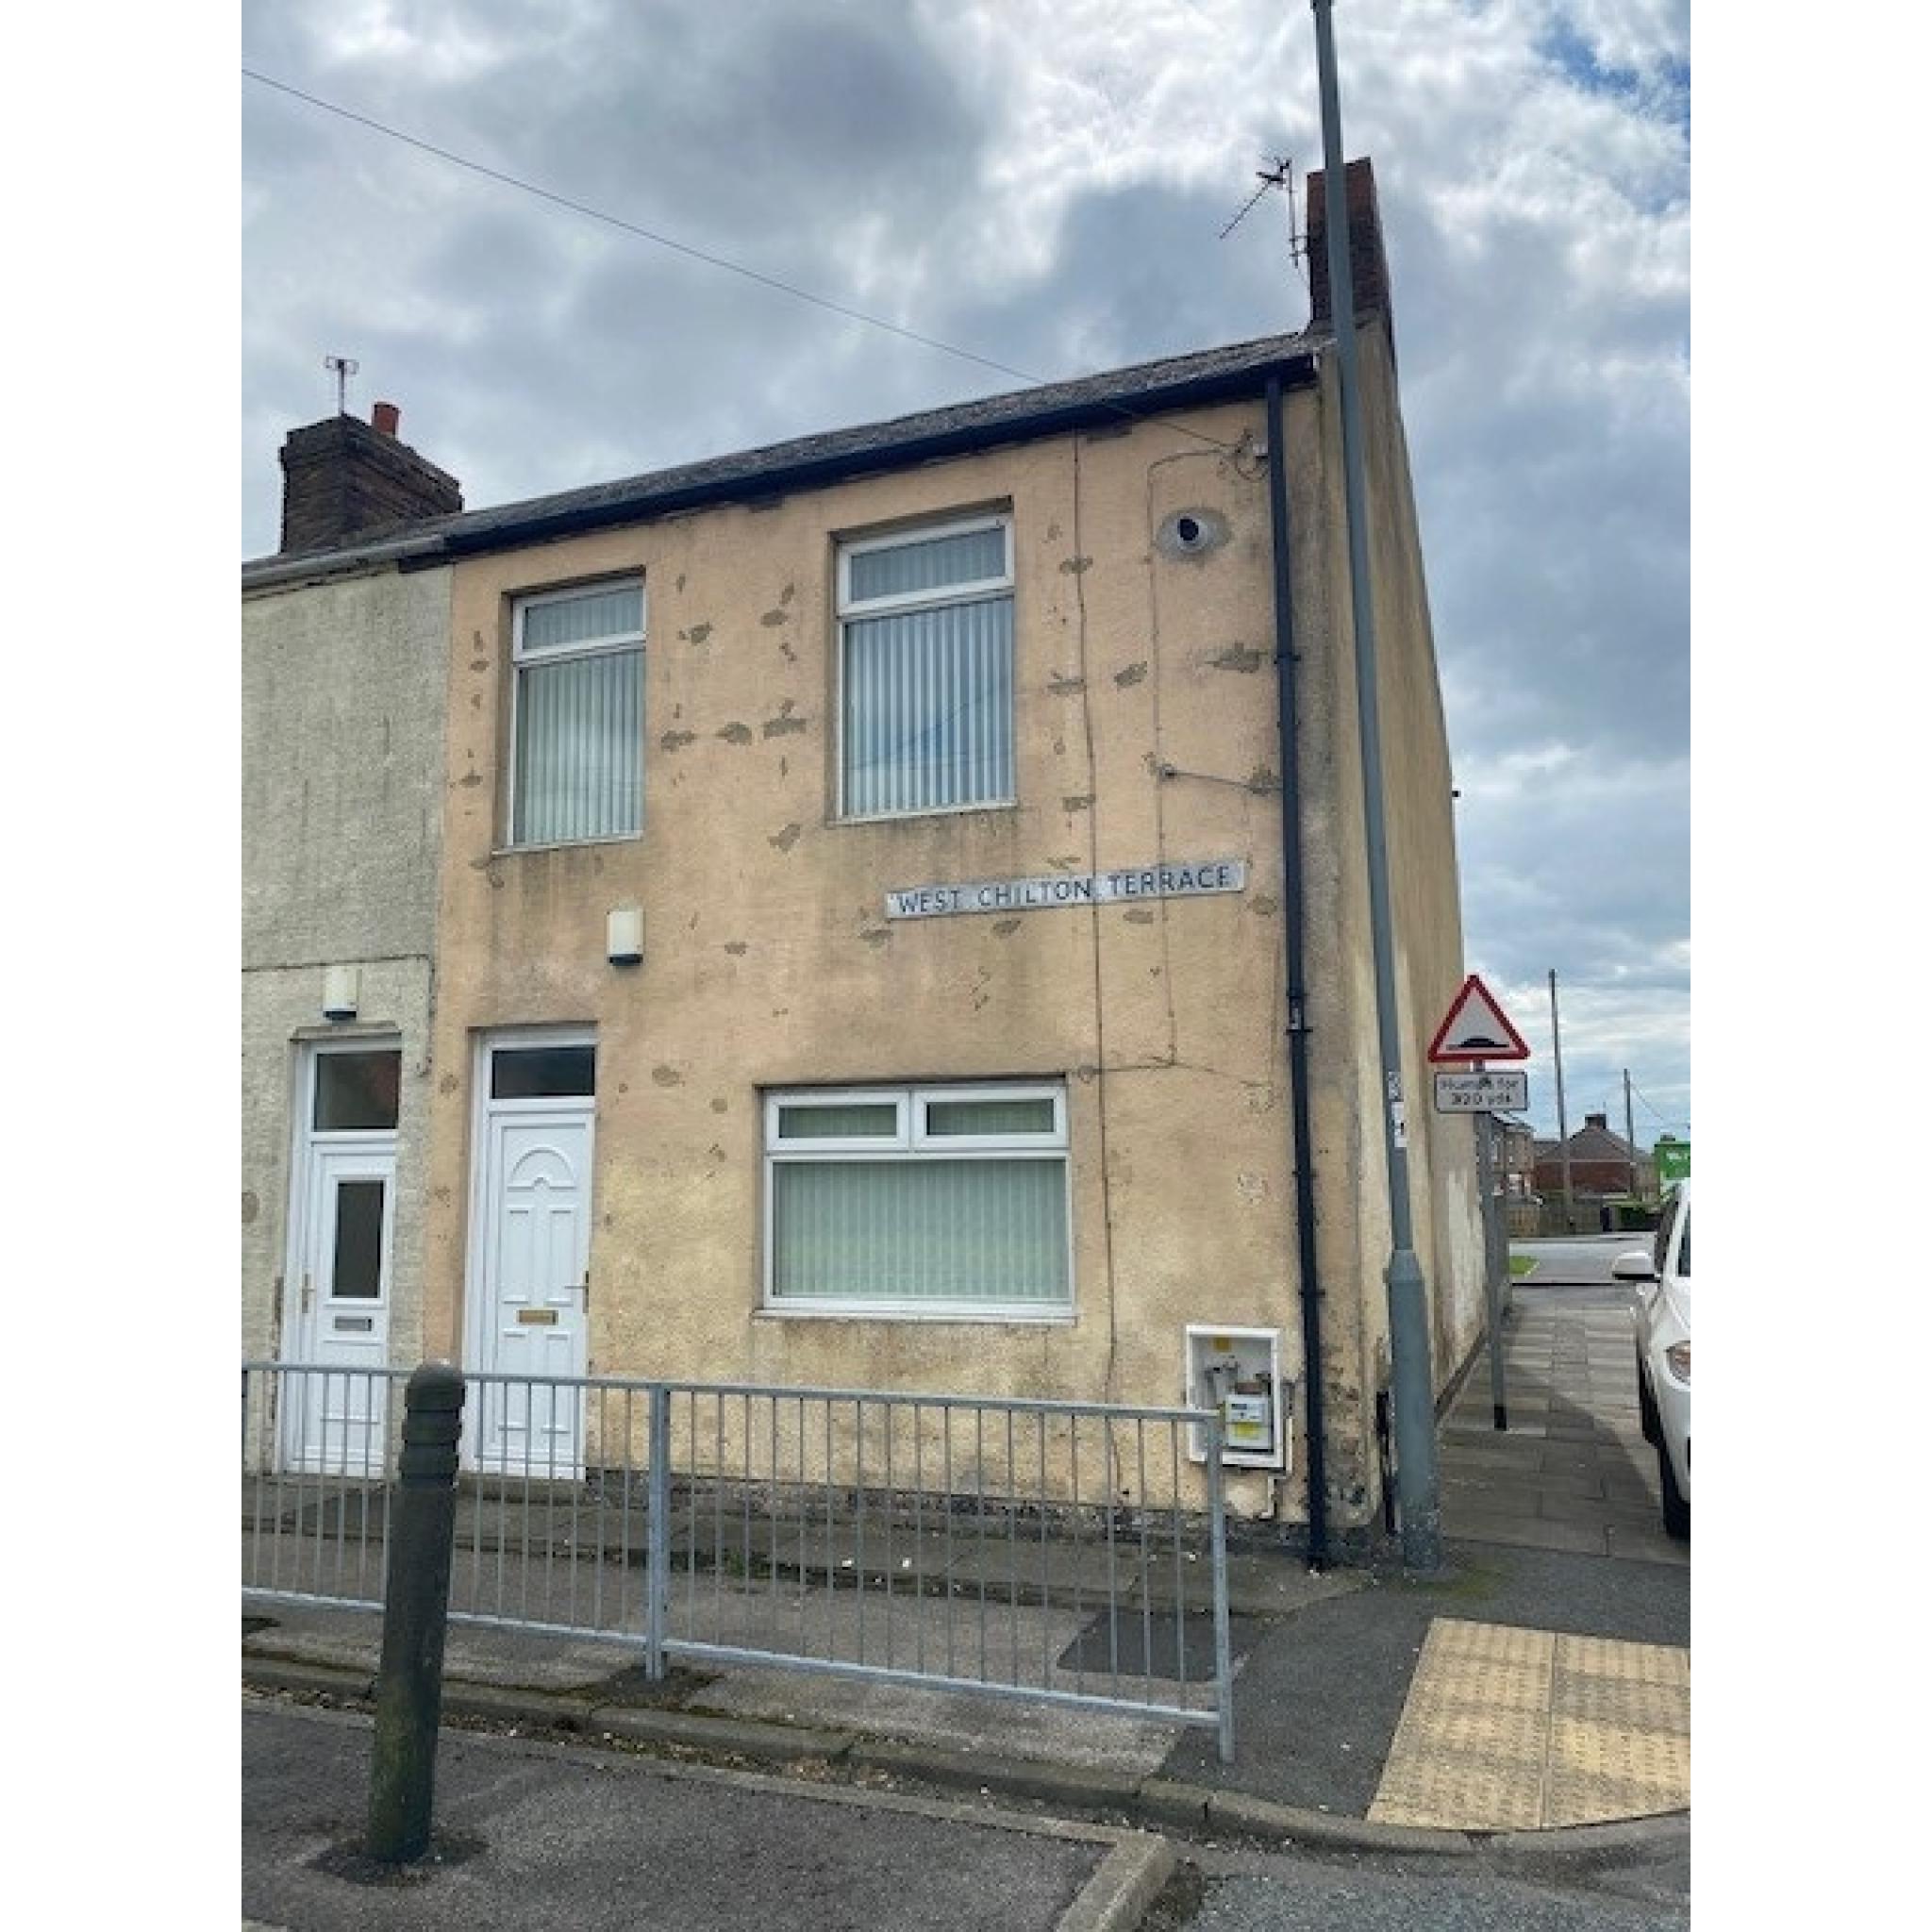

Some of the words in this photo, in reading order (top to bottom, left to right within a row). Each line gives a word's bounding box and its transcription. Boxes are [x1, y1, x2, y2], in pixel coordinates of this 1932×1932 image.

[899, 890, 961, 913] WEST
[978, 878, 1092, 907] CHILTON
[1108, 865, 1228, 895] TERRACE
